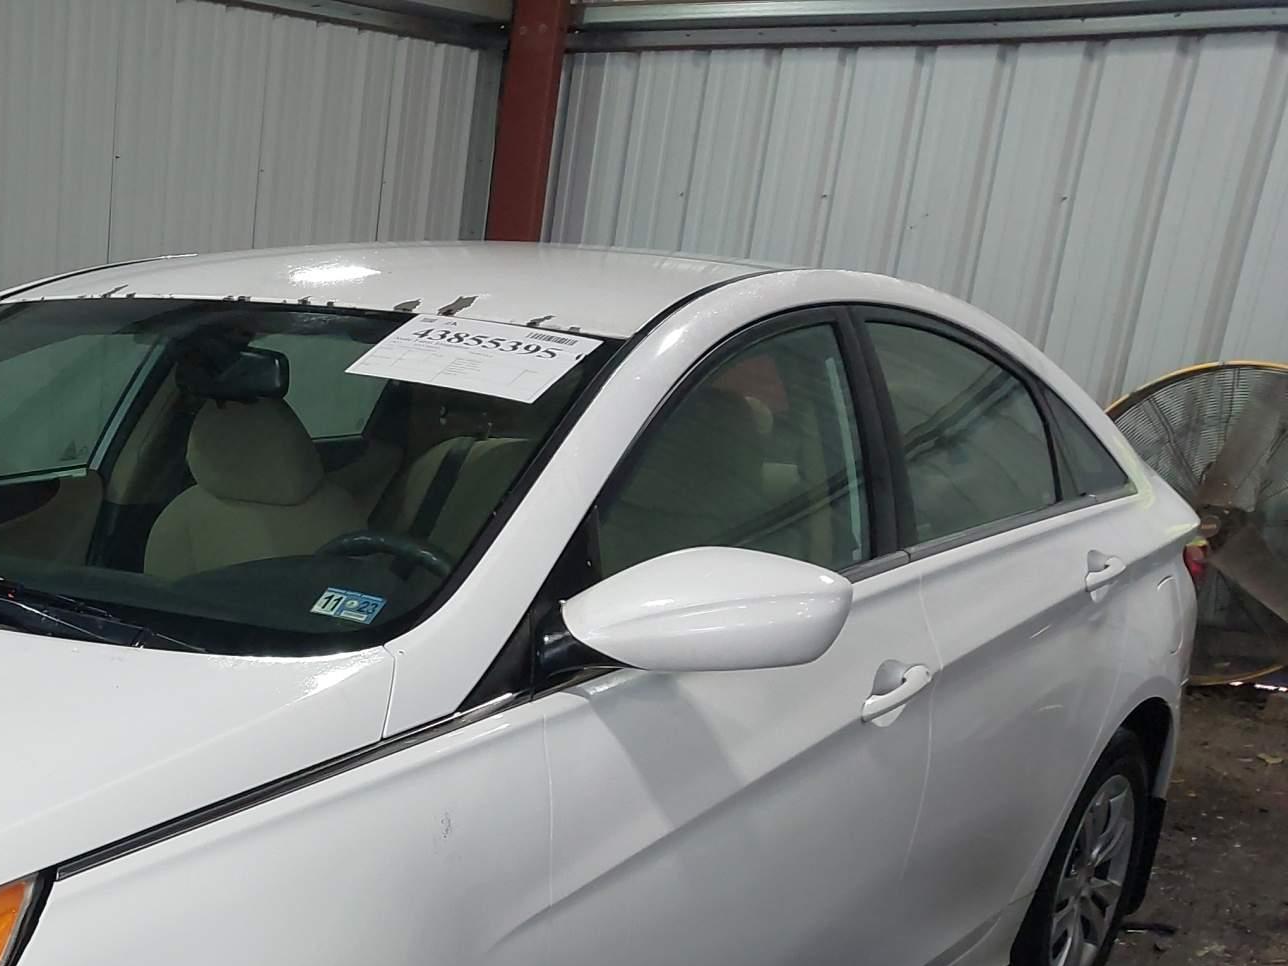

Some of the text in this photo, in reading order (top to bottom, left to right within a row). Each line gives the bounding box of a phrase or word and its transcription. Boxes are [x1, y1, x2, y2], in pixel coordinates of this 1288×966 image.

[414, 329, 562, 359] 43855395
[321, 594, 378, 614] 11 23
